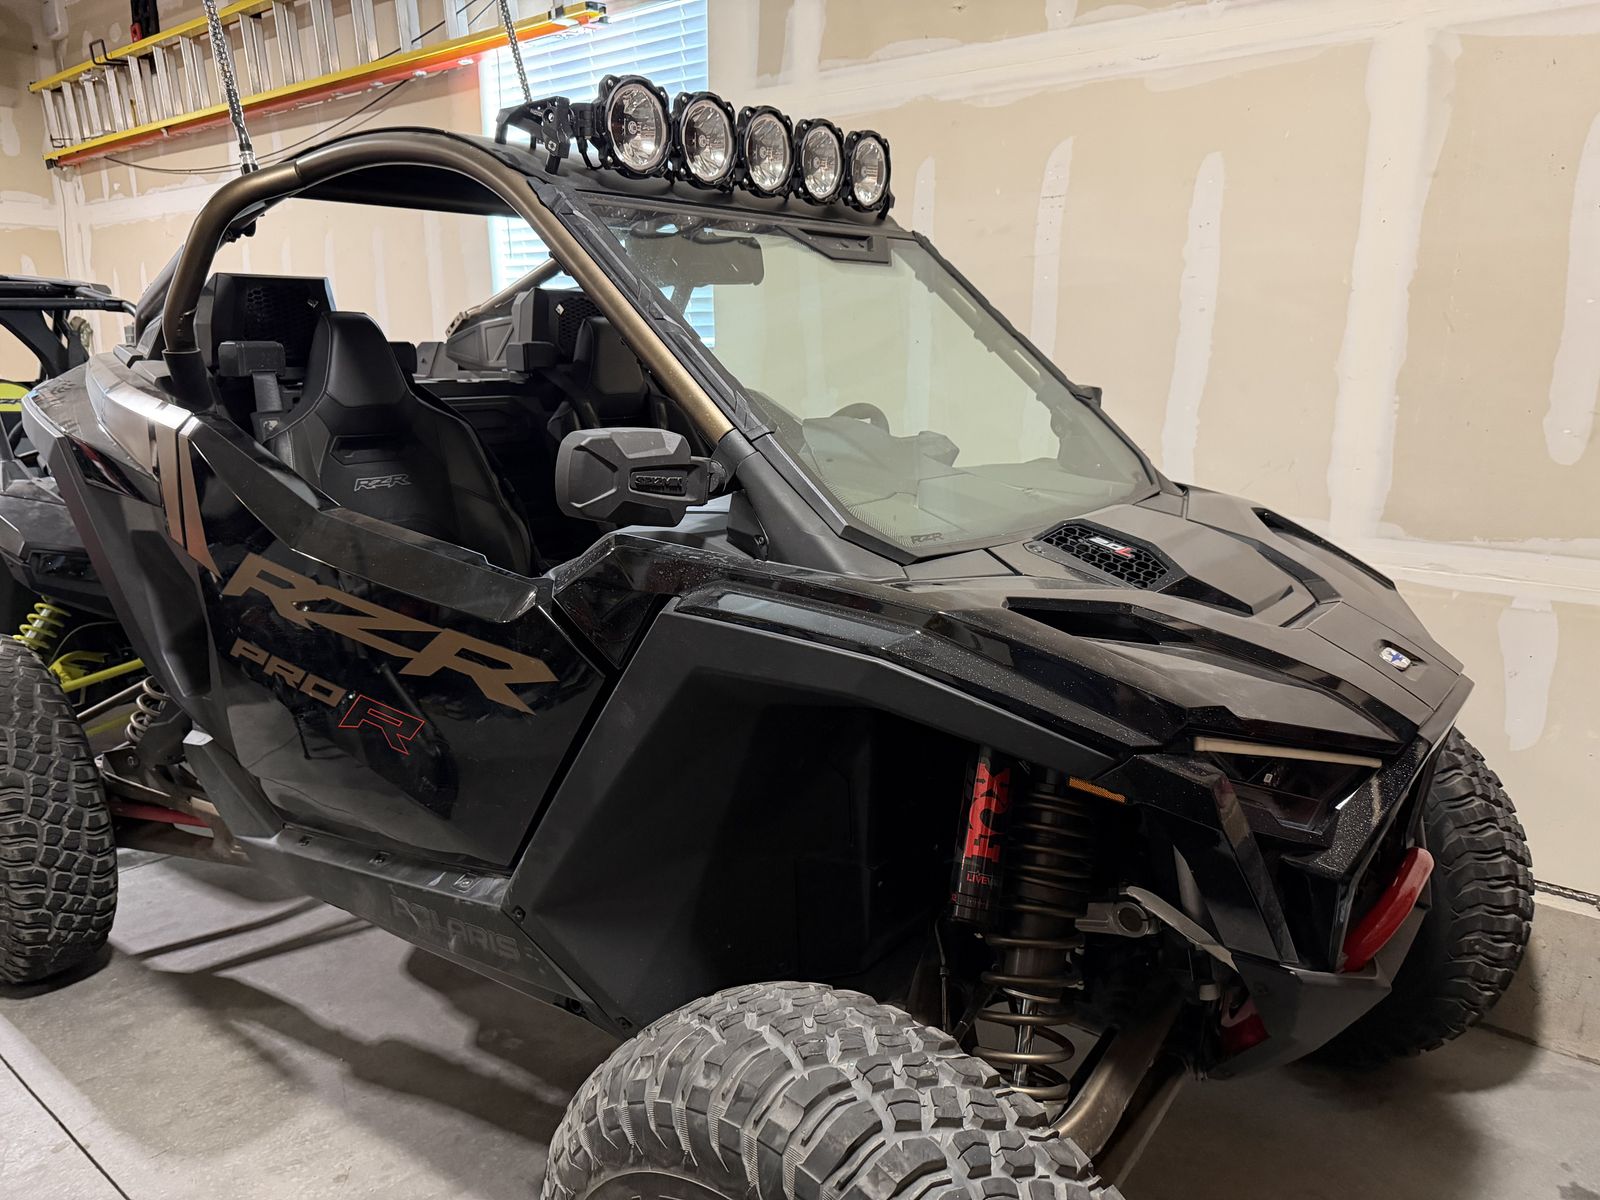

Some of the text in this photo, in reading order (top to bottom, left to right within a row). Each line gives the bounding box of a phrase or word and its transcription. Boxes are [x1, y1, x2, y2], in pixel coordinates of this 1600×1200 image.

[354, 474, 412, 491] RZR
[221, 552, 560, 716] RZR
[229, 637, 426, 755] PRO R
[963, 762, 1011, 863] FOX
